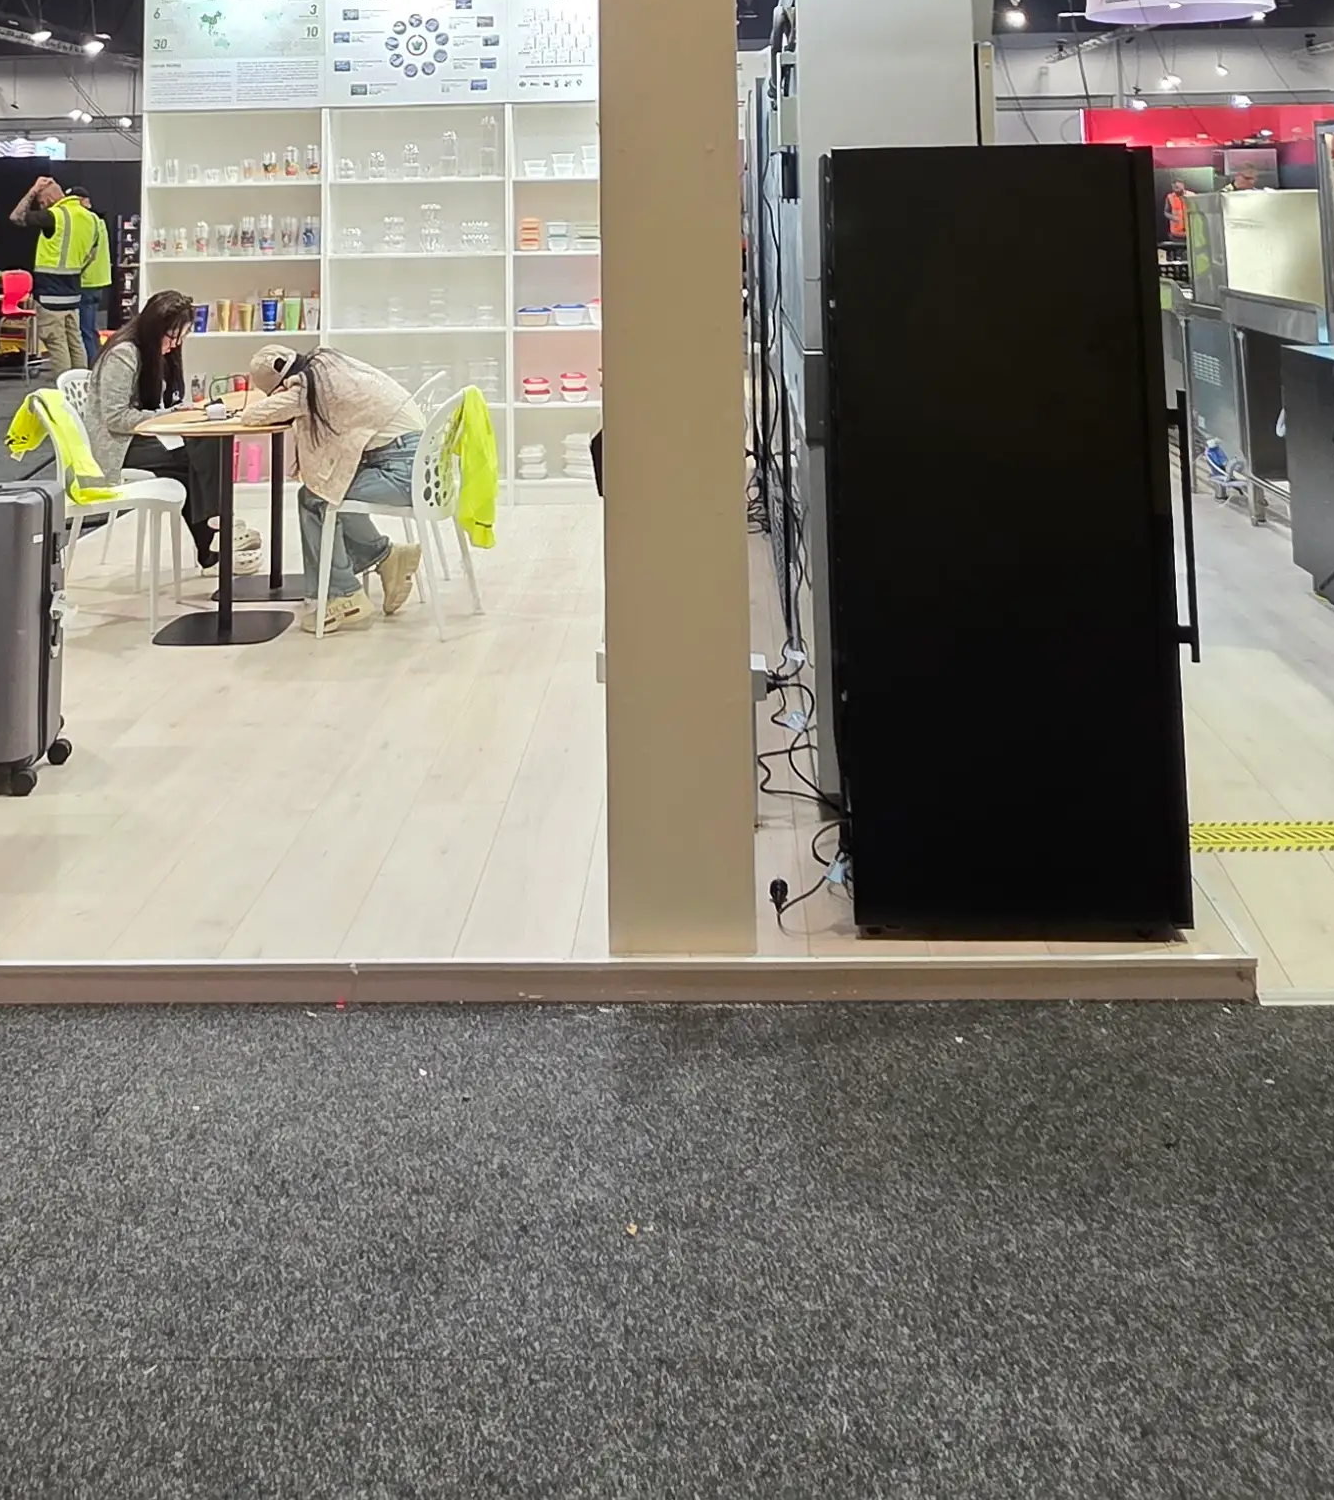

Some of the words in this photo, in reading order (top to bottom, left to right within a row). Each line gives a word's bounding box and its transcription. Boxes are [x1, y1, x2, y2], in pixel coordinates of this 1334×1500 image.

[309, 4, 317, 15] 3
[306, 26, 319, 37] 10
[153, 39, 167, 50] 30
